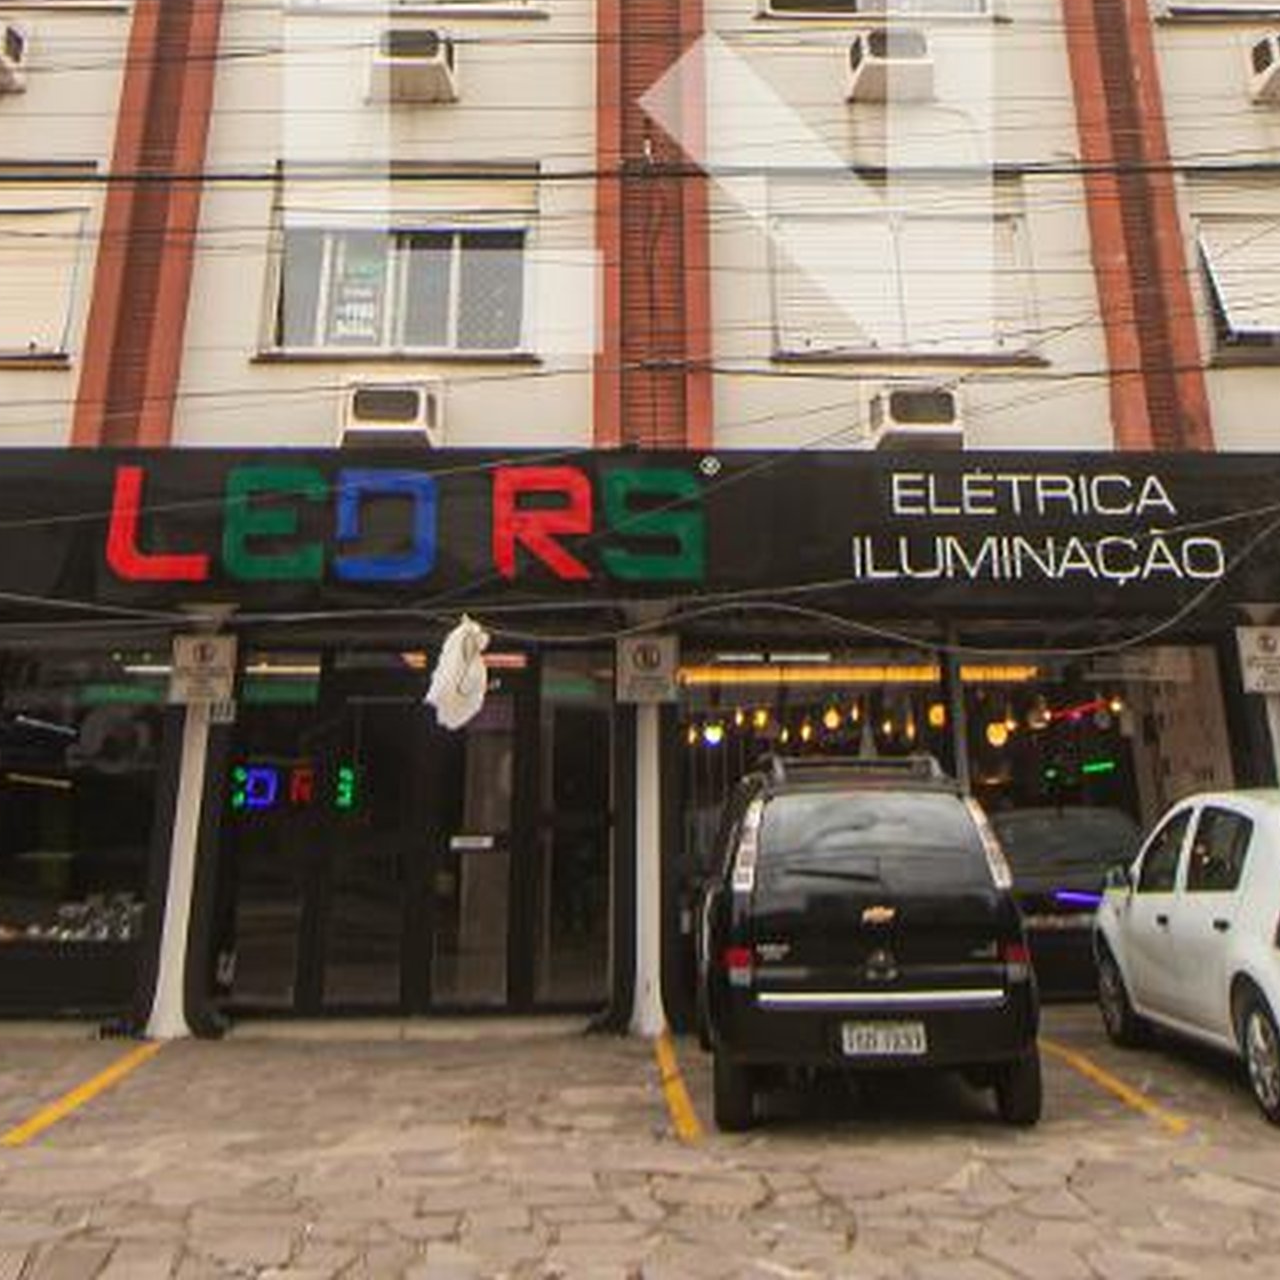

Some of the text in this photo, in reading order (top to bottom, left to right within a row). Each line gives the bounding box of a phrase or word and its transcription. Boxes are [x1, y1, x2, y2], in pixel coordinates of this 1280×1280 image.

[891, 467, 1177, 516] ELÉTRICA
[106, 465, 705, 581] LED RS
[852, 528, 1225, 587] ILUMINAÇÃO
